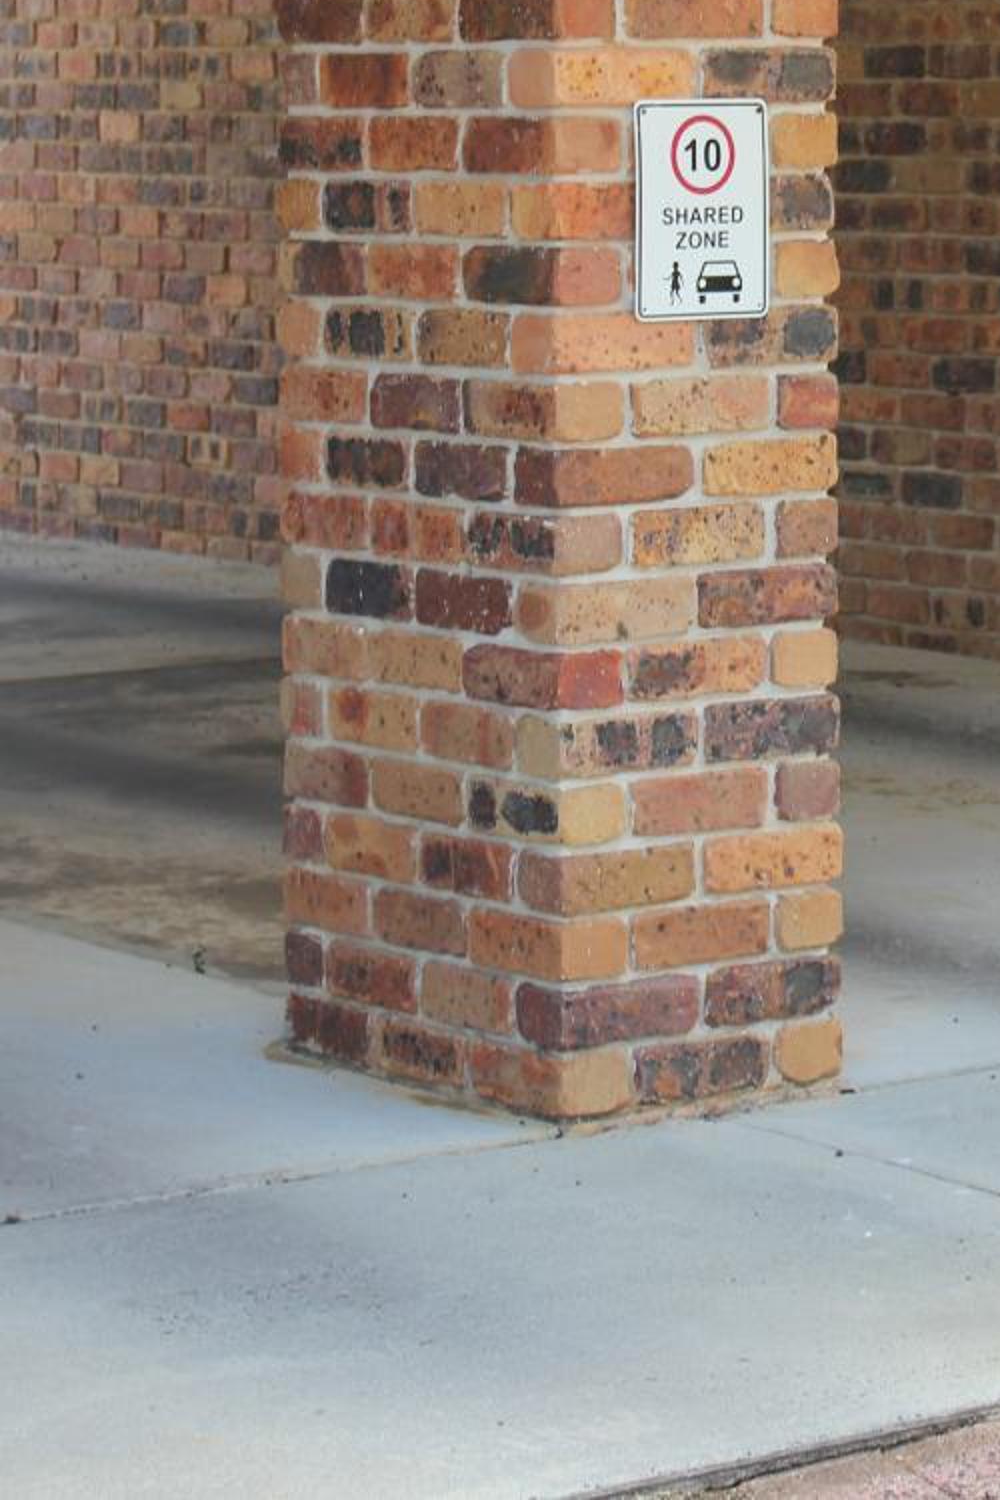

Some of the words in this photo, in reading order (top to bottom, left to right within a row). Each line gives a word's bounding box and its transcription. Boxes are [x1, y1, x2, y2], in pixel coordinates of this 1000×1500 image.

[684, 138, 722, 172] 10
[662, 205, 744, 226] SHARED
[675, 230, 730, 250] ZONE
